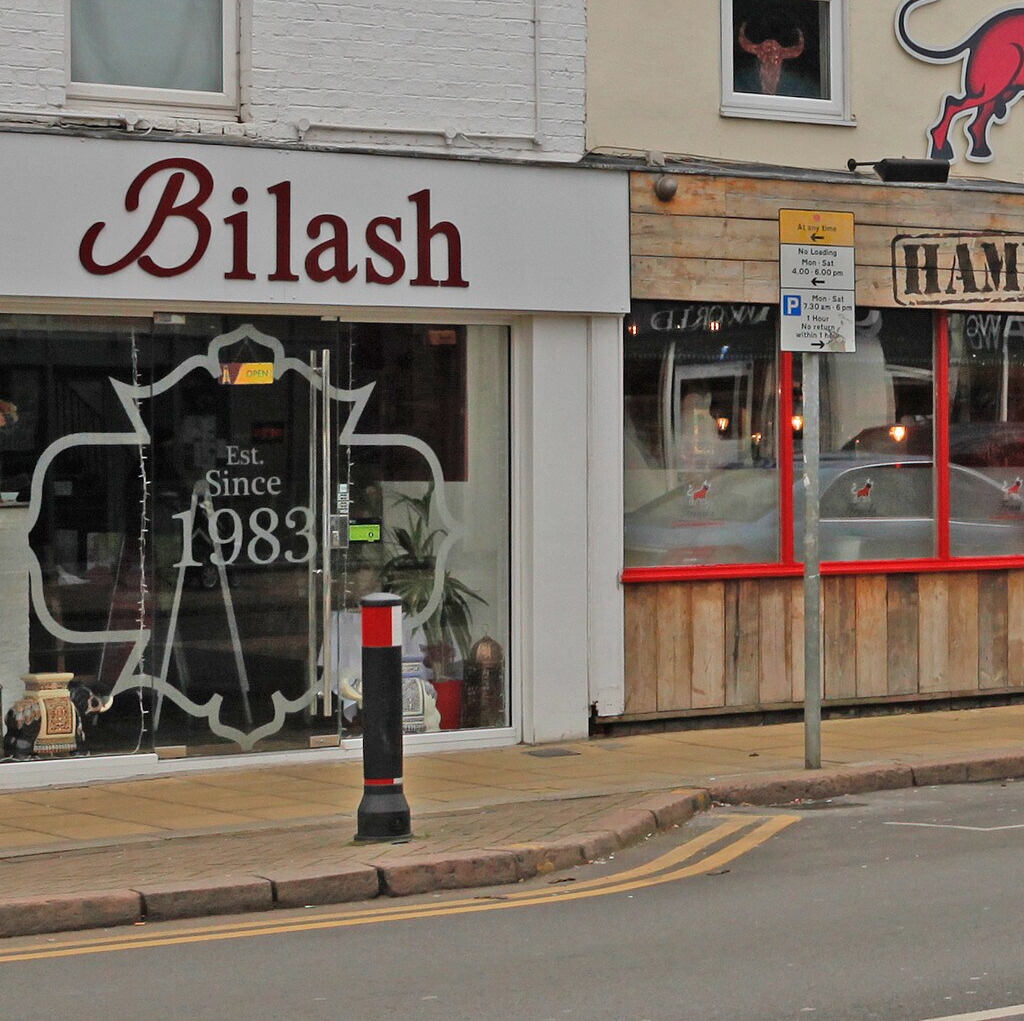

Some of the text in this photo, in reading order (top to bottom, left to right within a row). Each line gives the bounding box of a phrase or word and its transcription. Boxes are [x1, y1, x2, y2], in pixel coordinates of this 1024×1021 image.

[79, 157, 469, 288] Bilash
[797, 223, 806, 231] At
[821, 224, 837, 232] time
[810, 248, 838, 257] Loading
[821, 259, 834, 267] Sat
[814, 268, 832, 276] 6.00
[832, 295, 844, 303] Sat
[801, 323, 836, 331] No return
[246, 369, 269, 378] OPEN
[226, 446, 265, 465] Est.
[206, 469, 282, 497] Since
[171, 506, 319, 568] 1983
